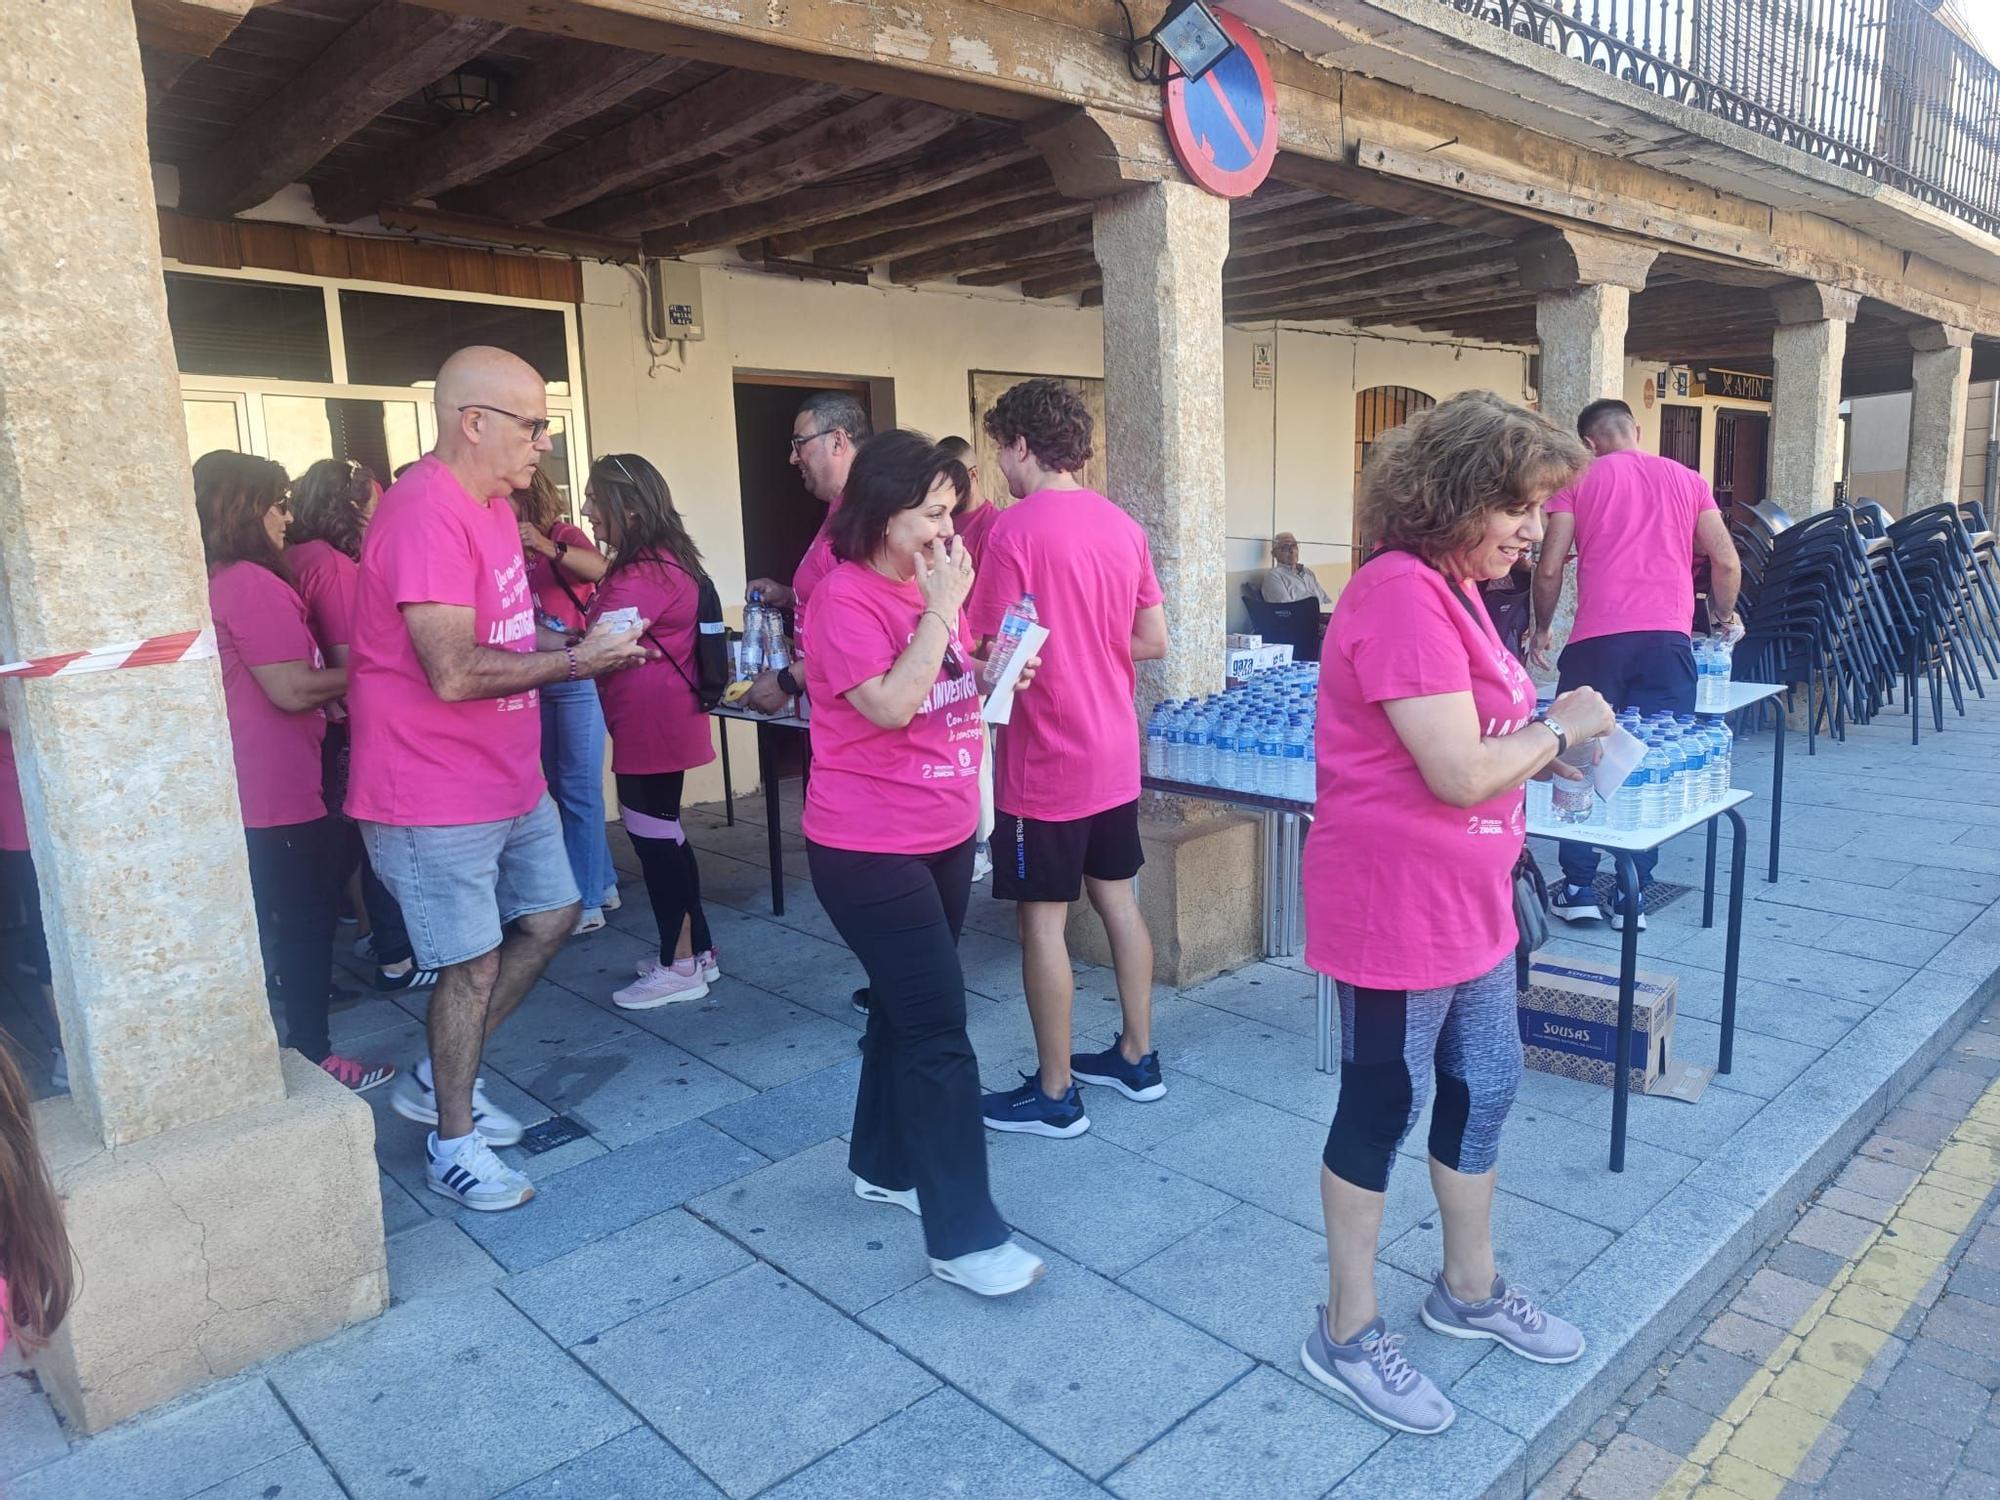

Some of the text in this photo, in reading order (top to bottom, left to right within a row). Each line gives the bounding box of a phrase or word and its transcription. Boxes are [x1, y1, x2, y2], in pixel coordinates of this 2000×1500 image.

[488, 620, 504, 644] LA
[1233, 658, 1254, 676] gaza
[917, 694, 932, 714] A
[1543, 1021, 1591, 1042] SOUSAS
